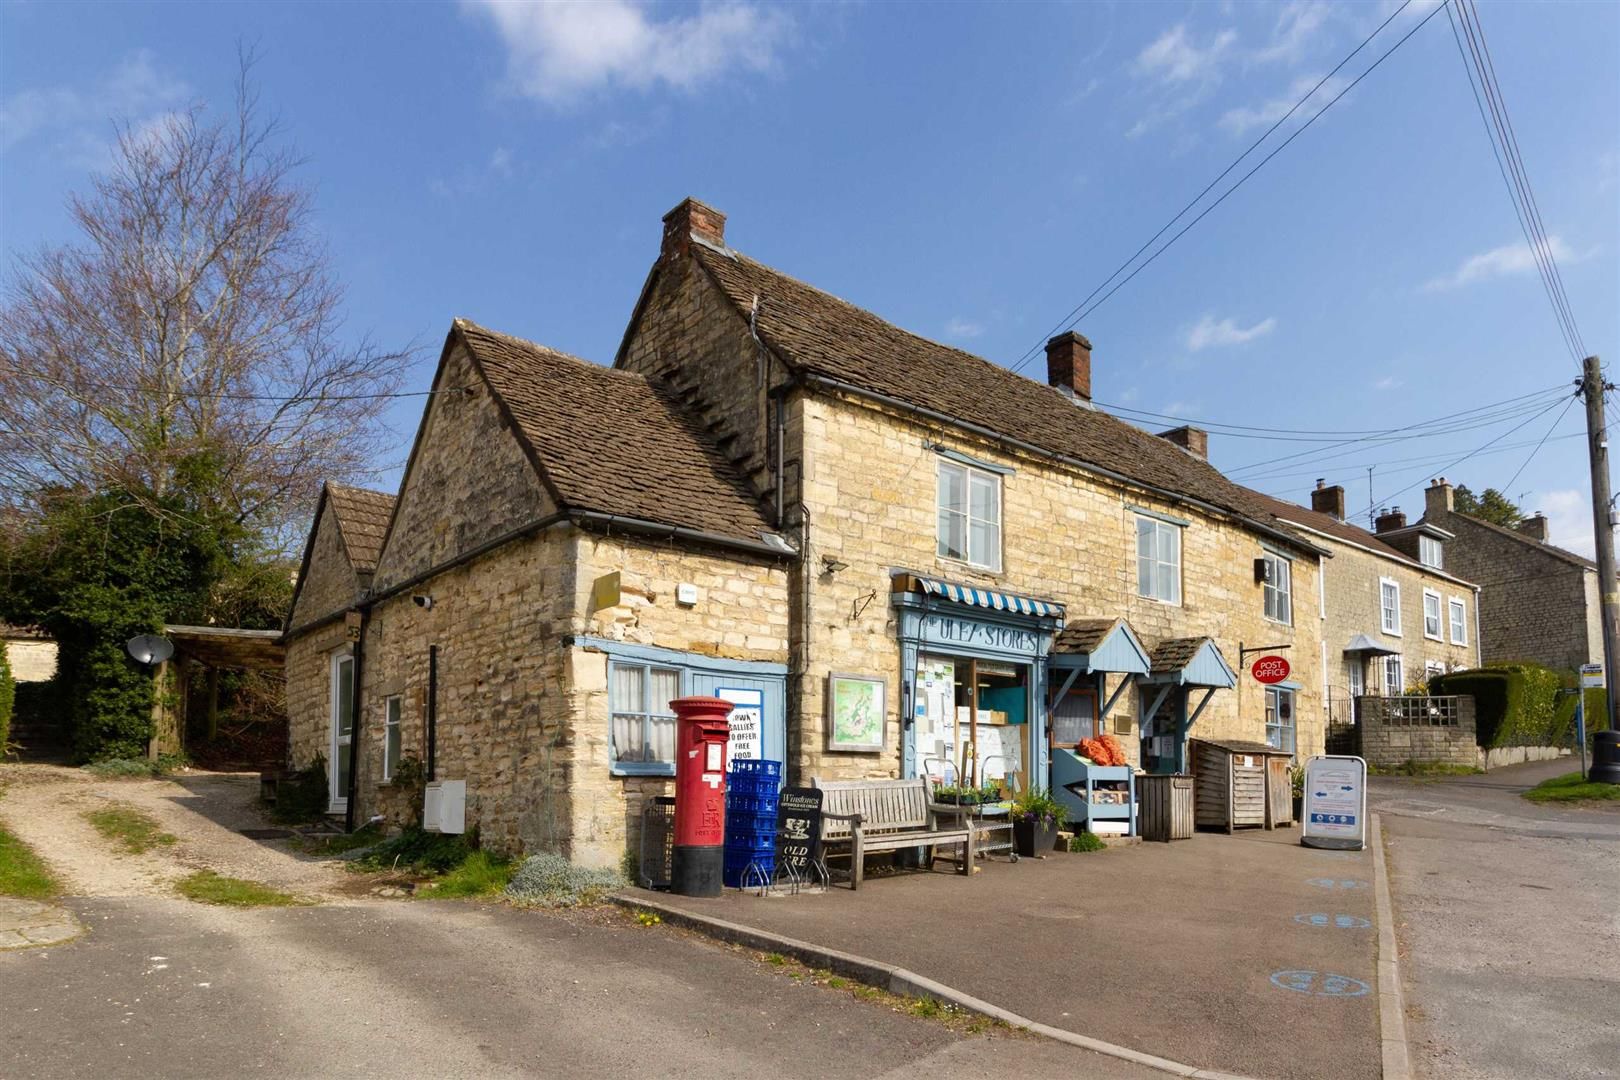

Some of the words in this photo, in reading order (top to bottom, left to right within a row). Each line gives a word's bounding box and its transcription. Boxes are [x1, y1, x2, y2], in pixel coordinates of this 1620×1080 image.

[940, 618, 977, 642] ULEY
[985, 625, 1036, 651] STORES
[1260, 661, 1282, 669] POST
[1255, 668, 1285, 677] OFFICE
[784, 846, 808, 857] OLD
